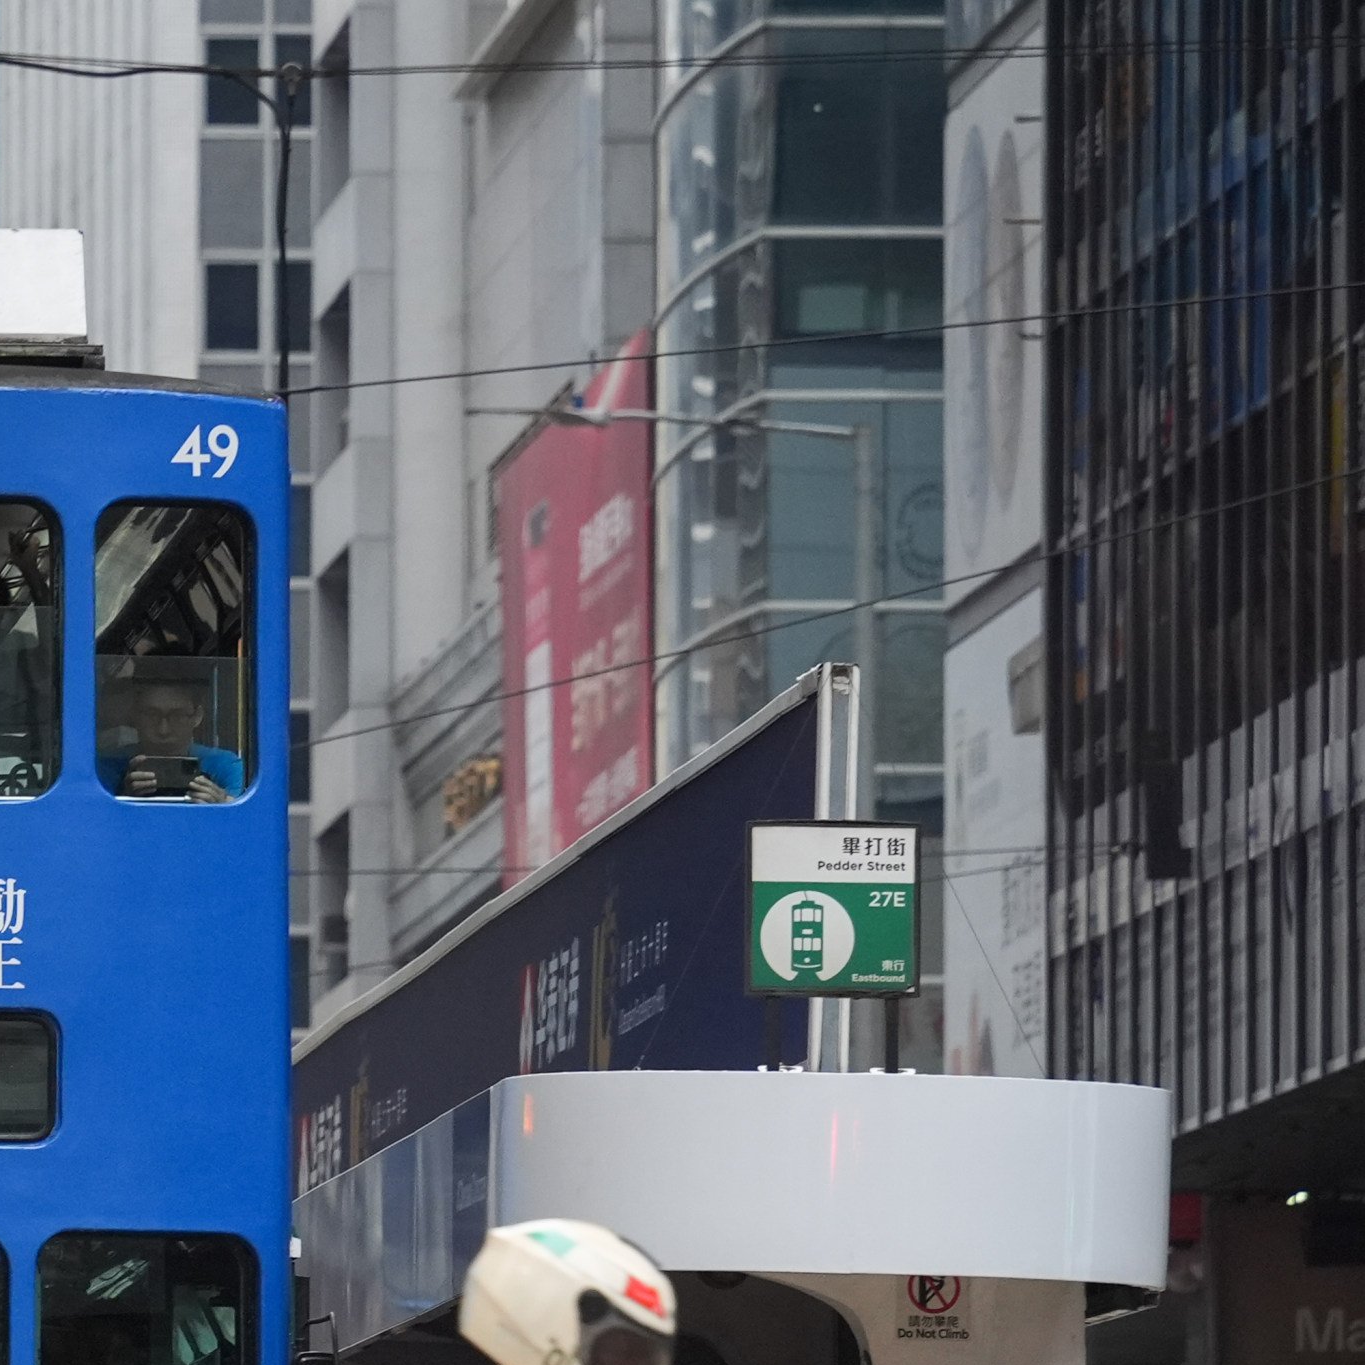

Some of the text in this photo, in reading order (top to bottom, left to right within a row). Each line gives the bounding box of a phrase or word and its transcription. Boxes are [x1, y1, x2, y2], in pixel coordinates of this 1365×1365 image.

[170, 424, 239, 478] 49
[842, 837, 906, 856] 畢打街
[818, 861, 906, 872] Pedder Street
[868, 891, 906, 907] 27E
[882, 959, 905, 972] 東行
[851, 973, 905, 983] Eastbound
[898, 1328, 970, 1339] Do Not Climb
